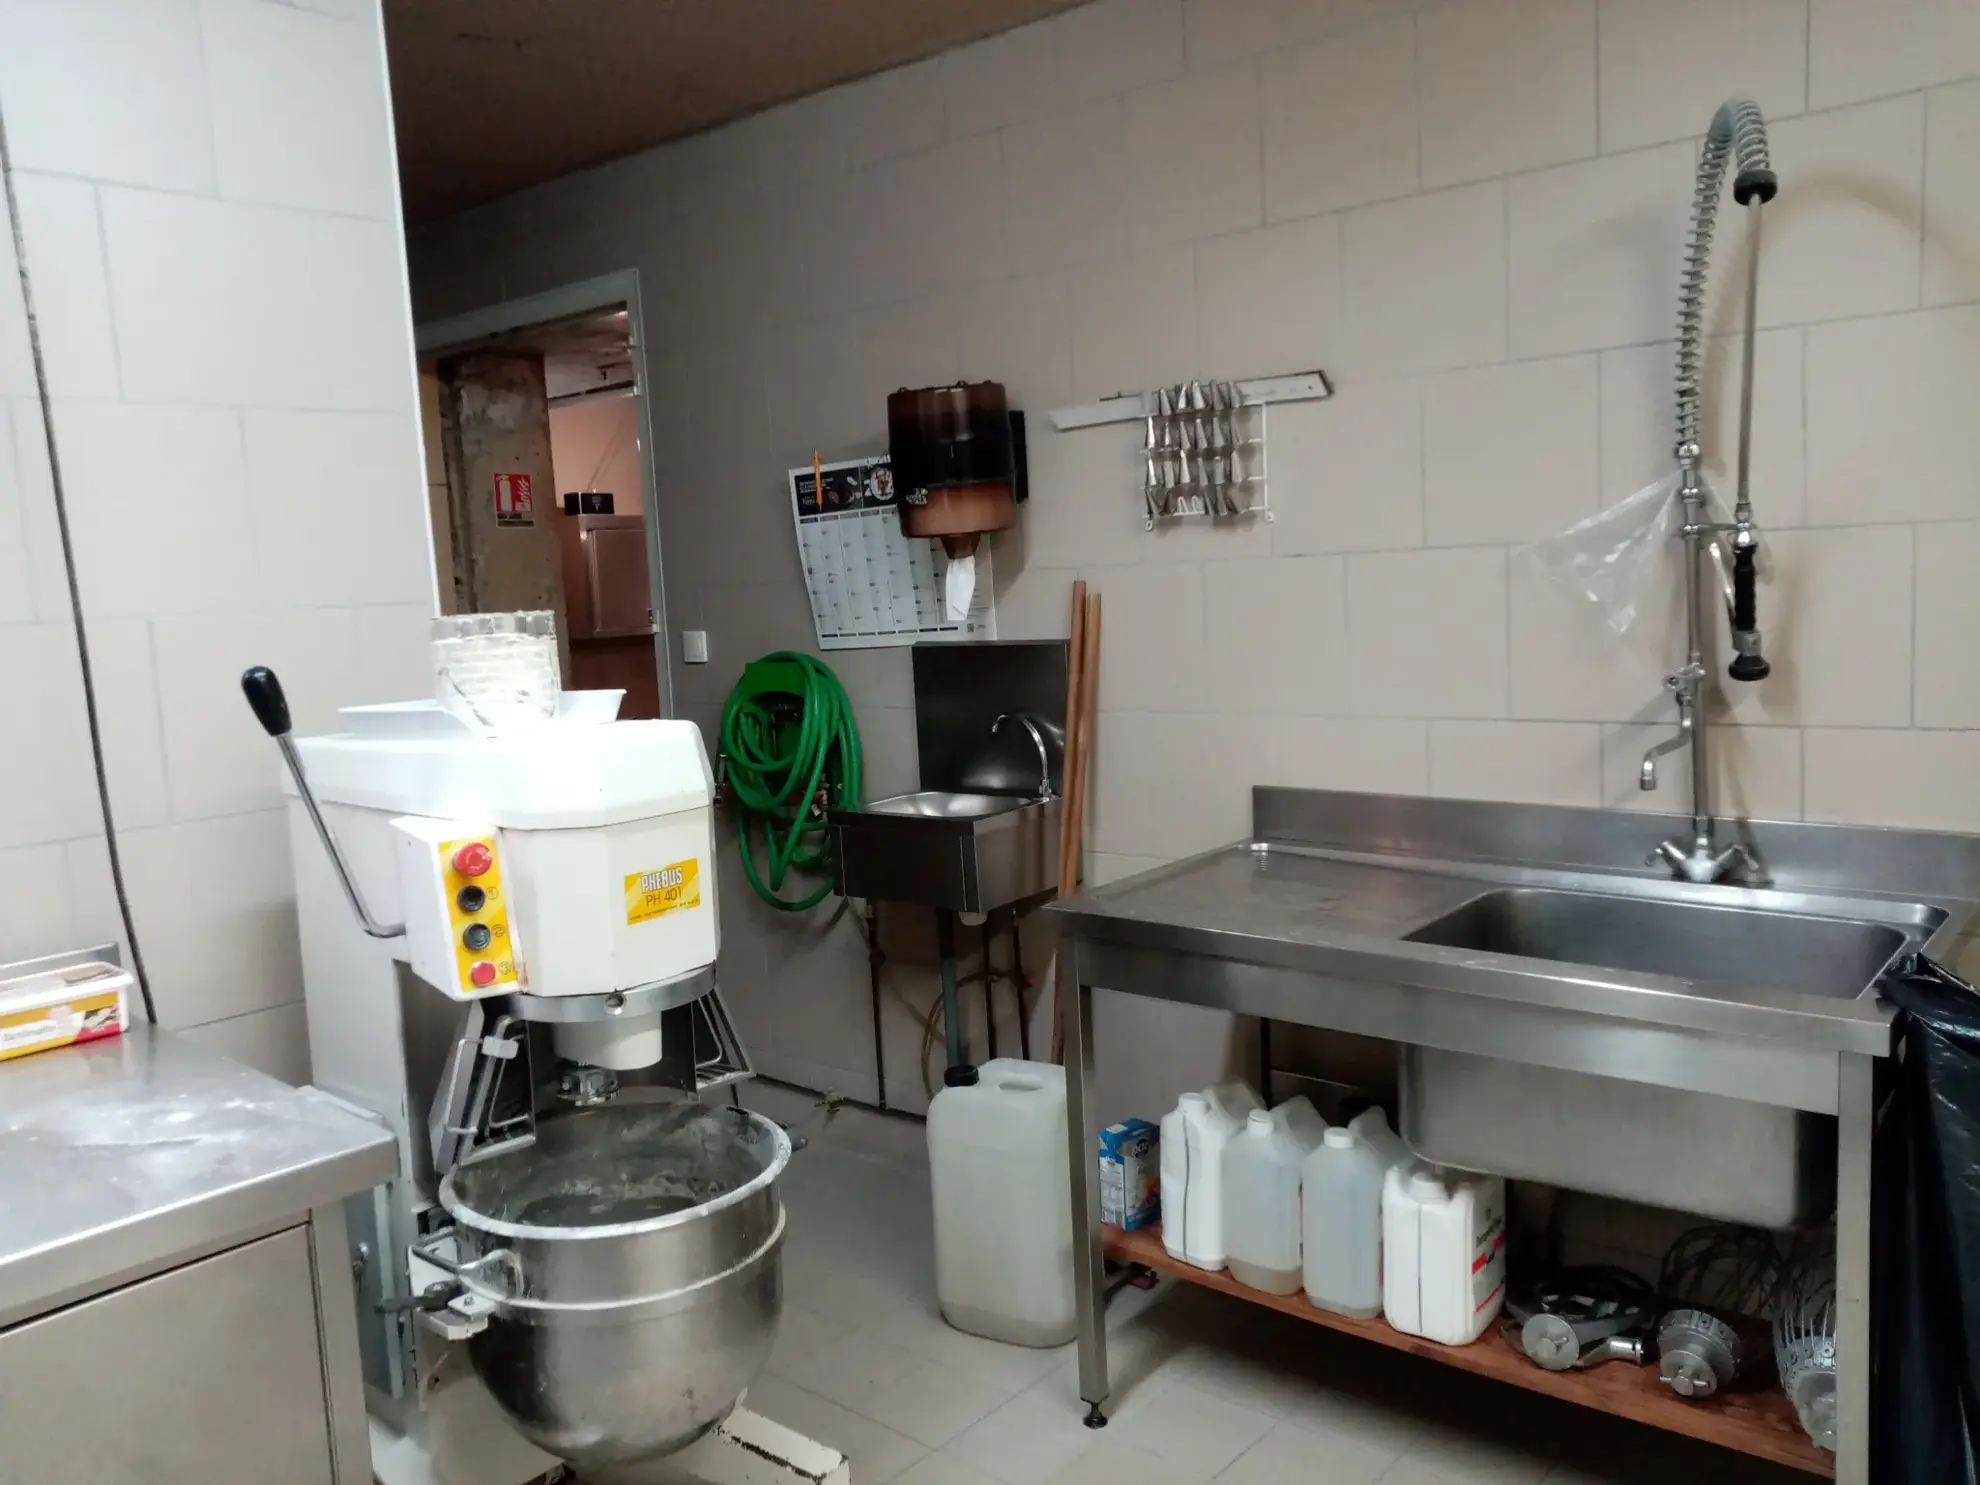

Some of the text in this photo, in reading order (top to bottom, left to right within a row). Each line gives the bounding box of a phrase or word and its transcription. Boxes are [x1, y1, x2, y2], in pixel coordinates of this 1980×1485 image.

[641, 867, 683, 894] PHEBUS
[646, 886, 682, 908] PH 401
